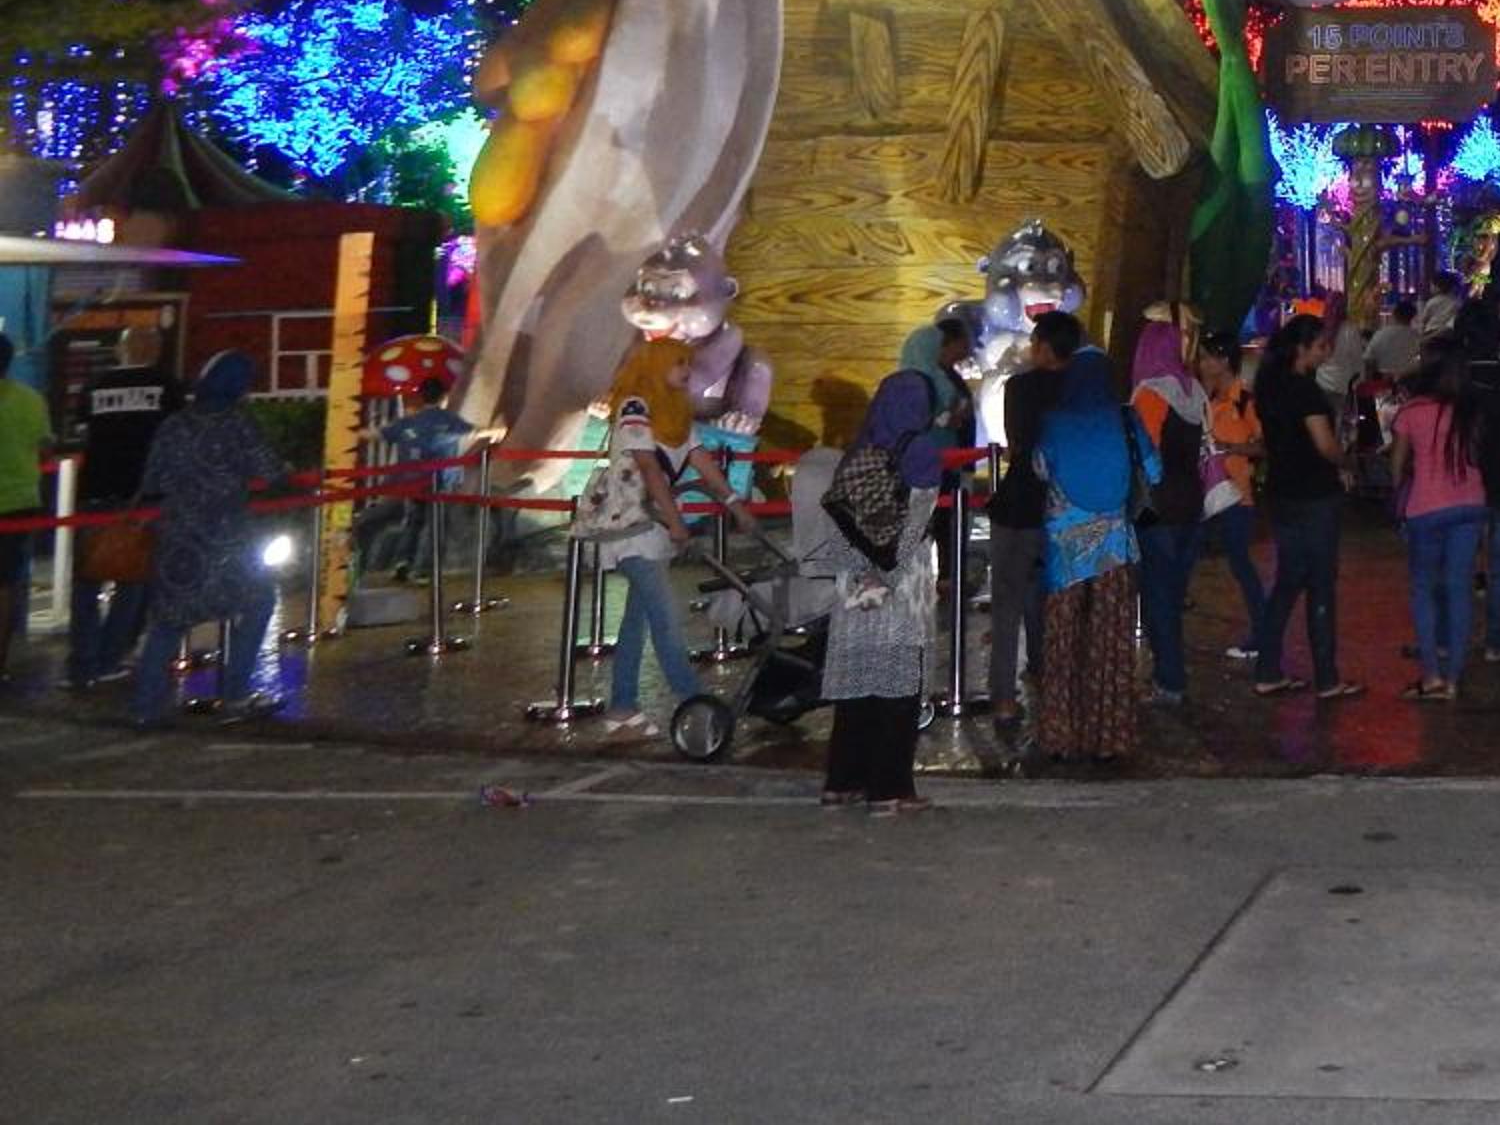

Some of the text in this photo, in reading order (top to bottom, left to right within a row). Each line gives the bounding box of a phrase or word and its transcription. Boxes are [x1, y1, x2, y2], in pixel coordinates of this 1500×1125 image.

[1351, 22, 1465, 49] POINTS
[1285, 51, 1486, 84] PER ENTRY
